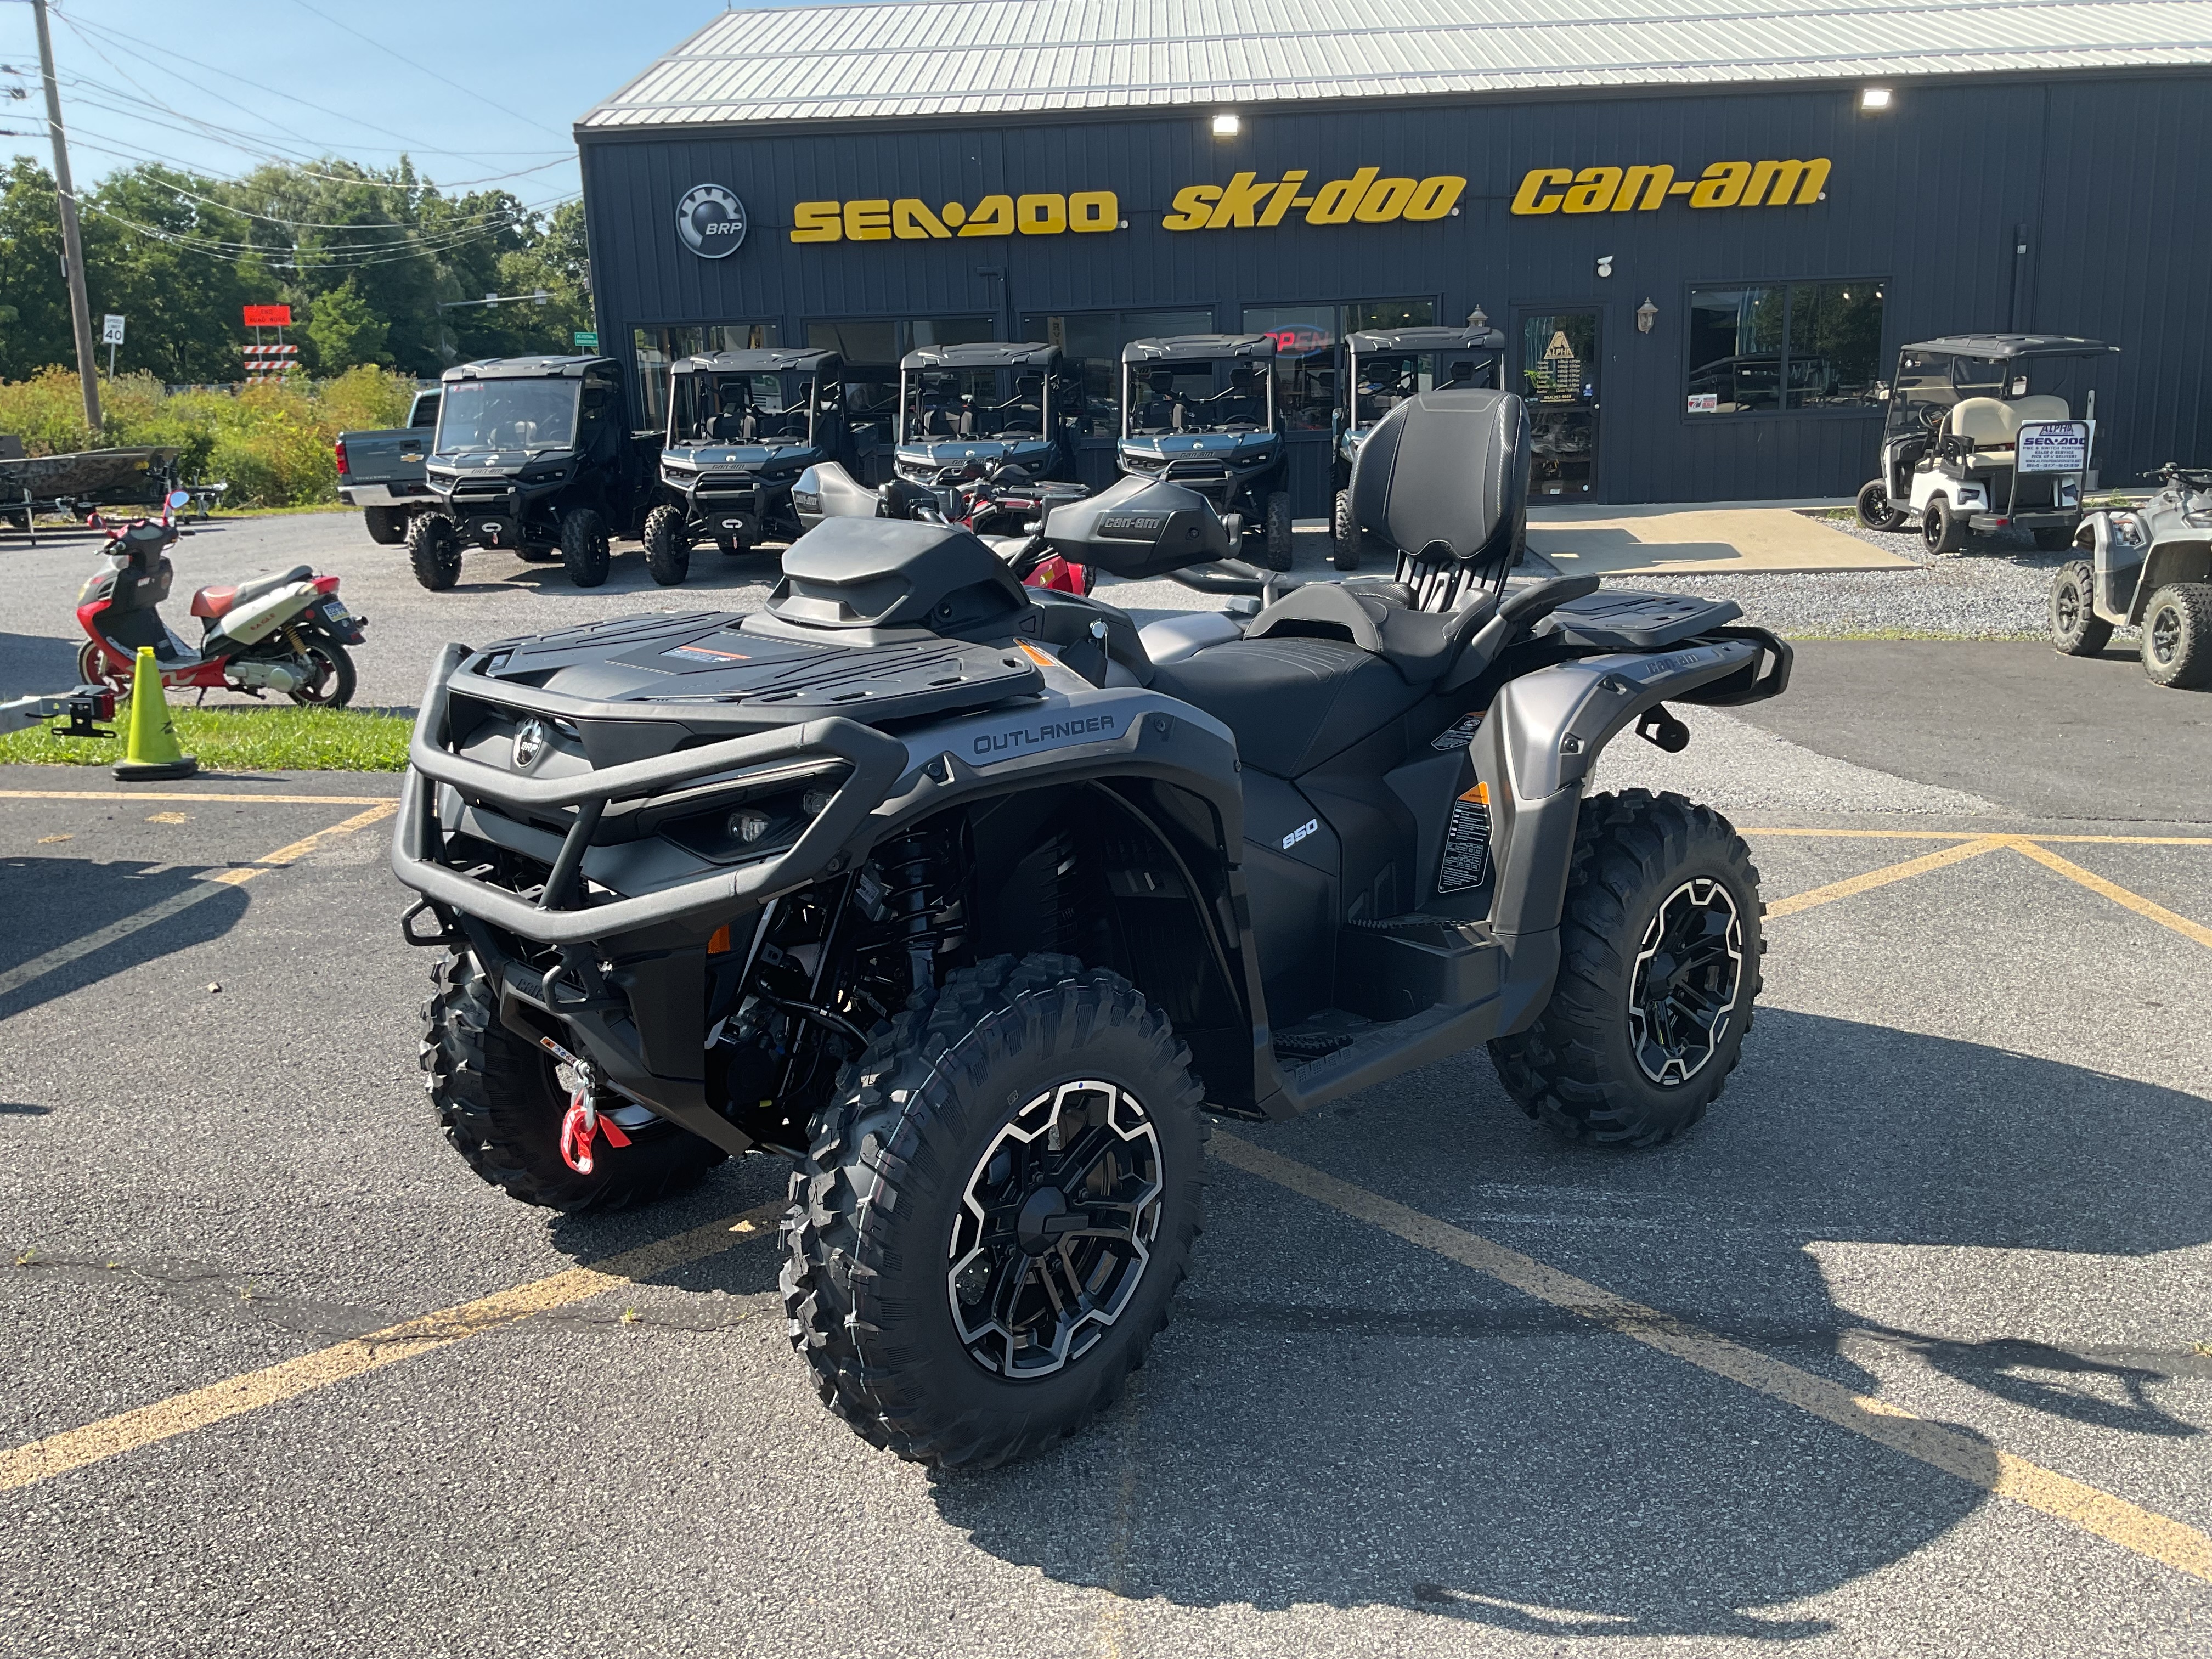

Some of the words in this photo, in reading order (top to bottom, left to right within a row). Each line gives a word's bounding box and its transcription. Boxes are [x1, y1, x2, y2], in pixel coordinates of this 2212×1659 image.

[1510, 158, 1831, 215] can-am
[1162, 167, 1466, 231] ski-doo
[706, 222, 742, 235] BRP
[105, 330, 121, 340] 40
[1264, 332, 1328, 351] PEN
[2042, 424, 2074, 433] ALPHA
[795, 495, 817, 506] can-am
[1104, 518, 1160, 528] can-am
[250, 613, 276, 630] EAGLE
[1646, 653, 1699, 674] can-am
[974, 715, 1114, 754] OUTLANDER
[521, 741, 539, 752] BRP
[1282, 818, 1318, 849] 850
